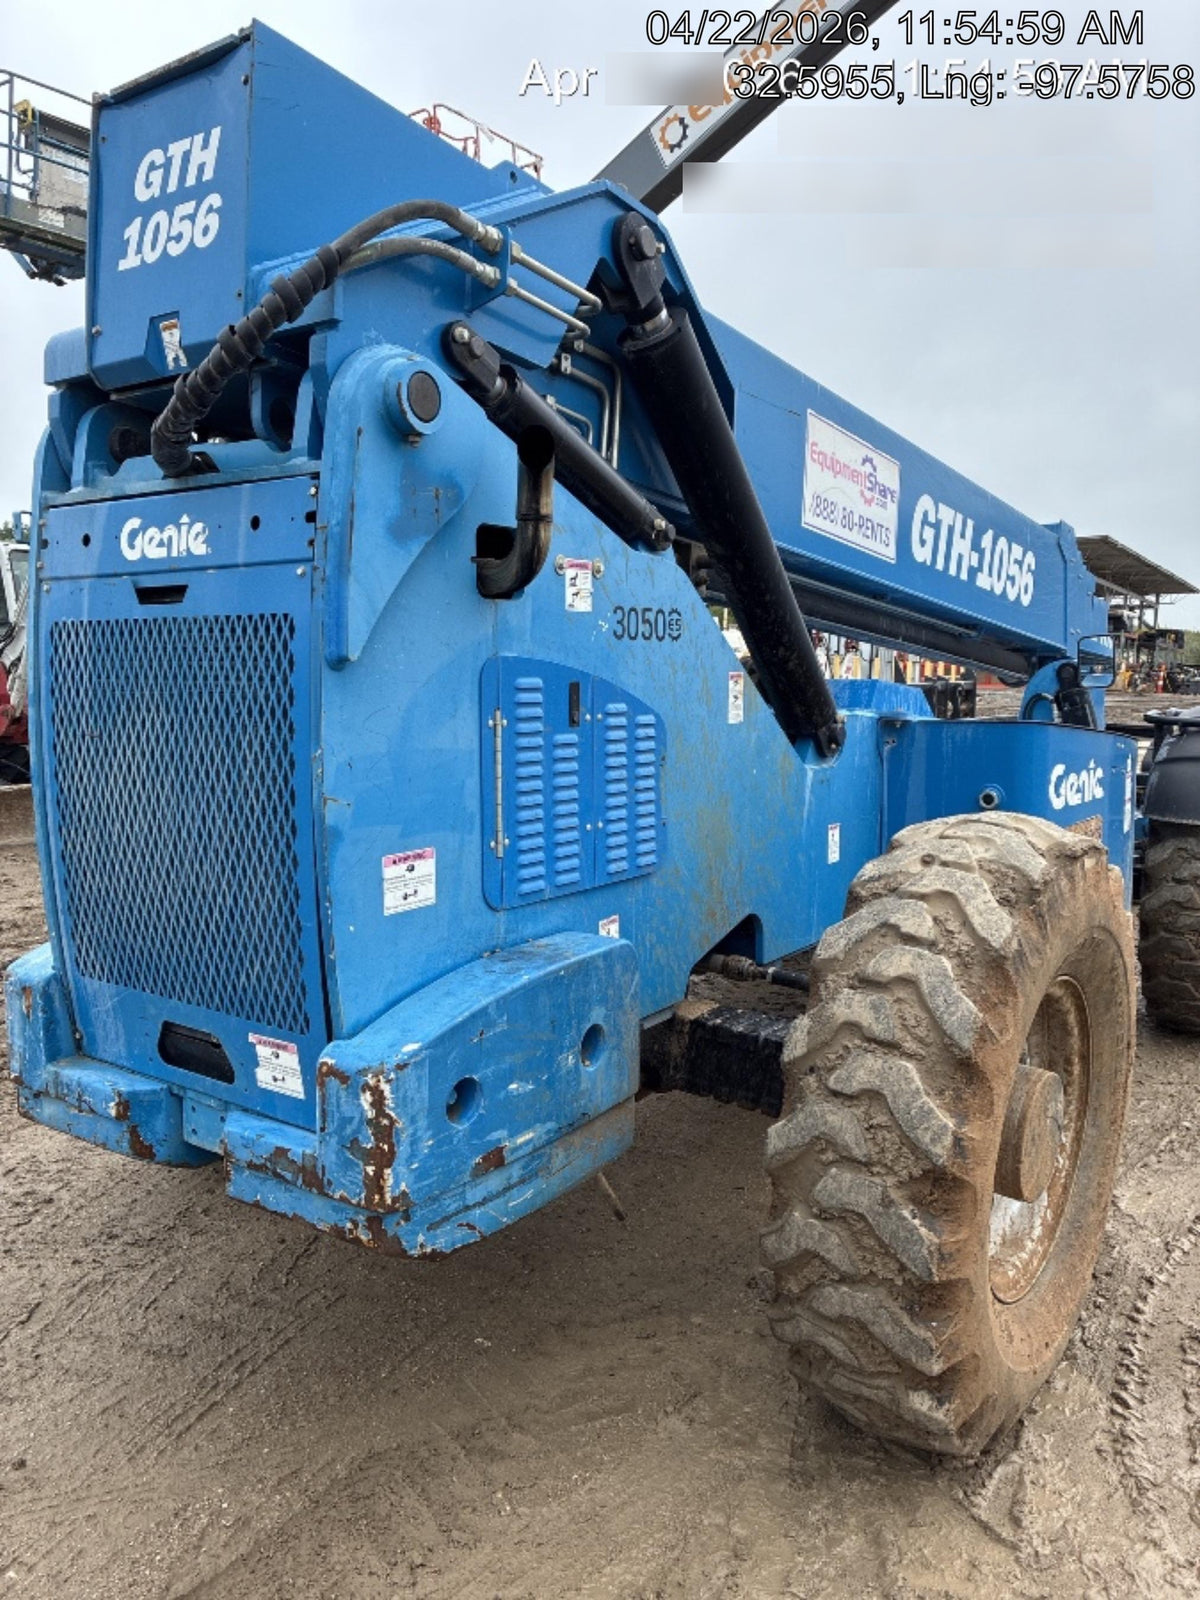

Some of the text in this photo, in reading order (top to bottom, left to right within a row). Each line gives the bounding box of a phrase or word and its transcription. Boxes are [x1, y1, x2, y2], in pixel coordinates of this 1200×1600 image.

[134, 126, 222, 202] GTH
[117, 193, 223, 271] 1056
[121, 513, 209, 561] Genie
[911, 494, 1036, 607] GTH-1056
[613, 606, 666, 642] 3050
[1049, 758, 1105, 810] Genie
